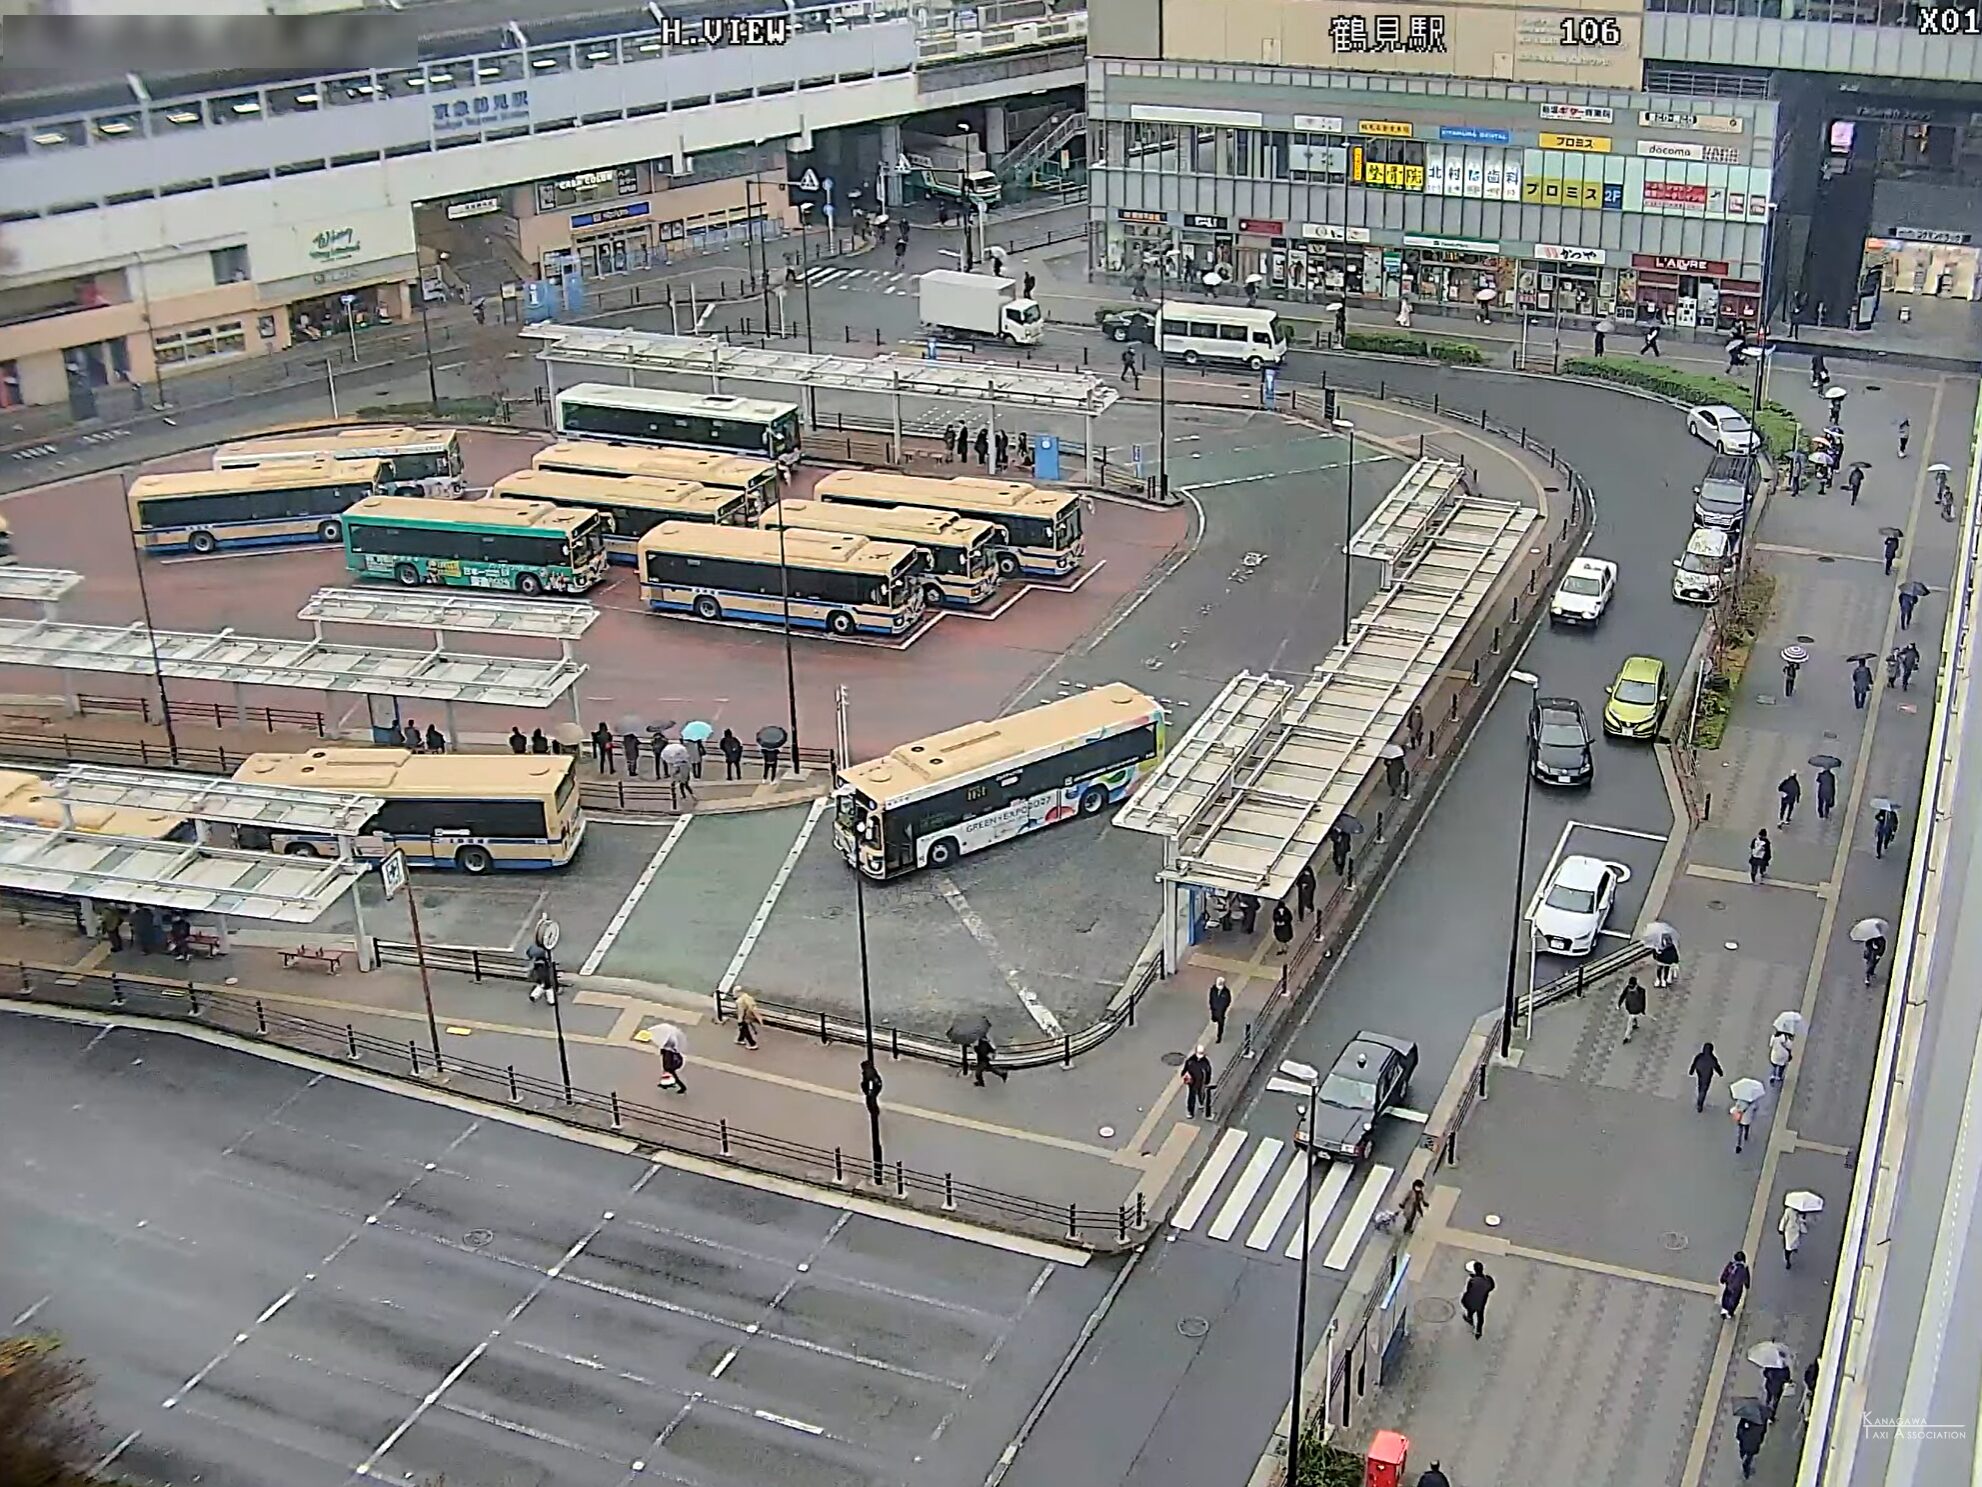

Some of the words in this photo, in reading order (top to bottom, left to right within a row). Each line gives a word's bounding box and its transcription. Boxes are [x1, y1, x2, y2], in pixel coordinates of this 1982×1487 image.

[1556, 137, 1594, 149] プロミス
[1648, 145, 1692, 157] docomo
[1525, 182, 1597, 201] プロミス
[1604, 190, 1622, 202] 2F
[1560, 247, 1597, 262] かつや
